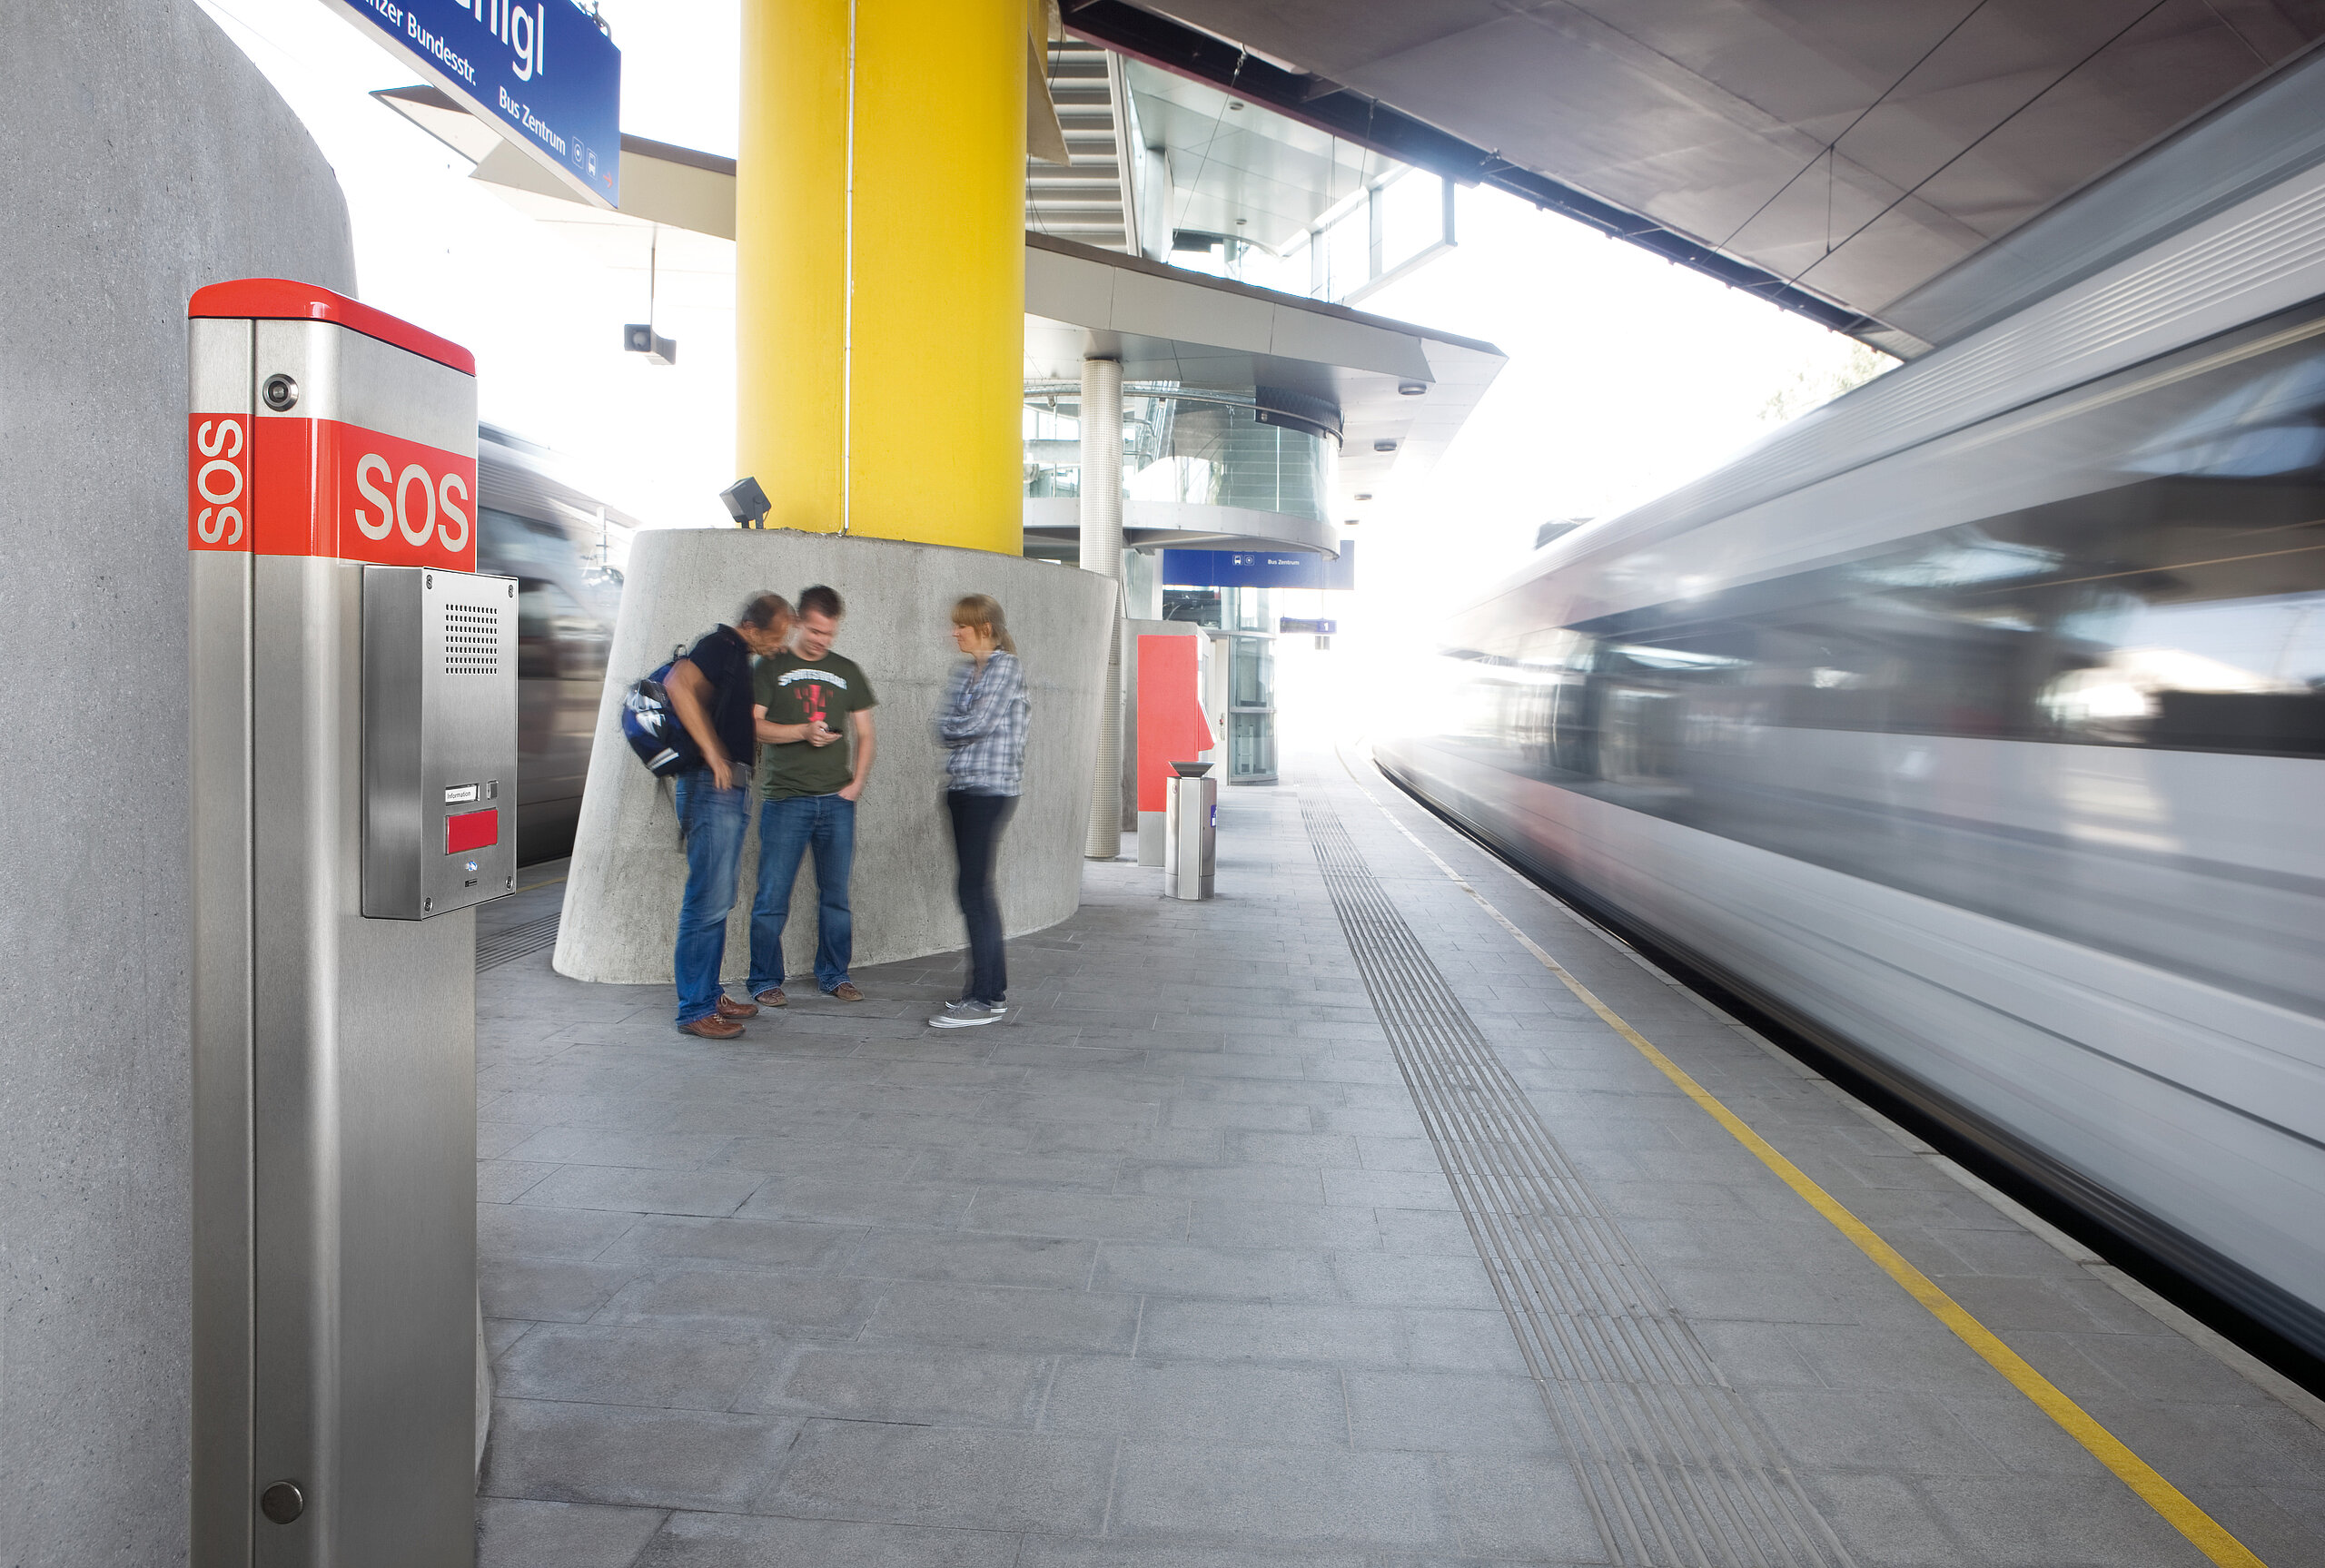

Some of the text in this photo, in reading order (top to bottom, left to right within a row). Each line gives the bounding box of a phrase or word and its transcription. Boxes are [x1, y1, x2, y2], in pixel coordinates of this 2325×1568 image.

[408, 12, 477, 86] Bundesstr.
[499, 84, 566, 156] Bus Zentrum
[197, 419, 243, 545] SOS
[354, 453, 469, 552] SOS
[1323, 622, 1329, 631] 1
[447, 791, 471, 799] Information
